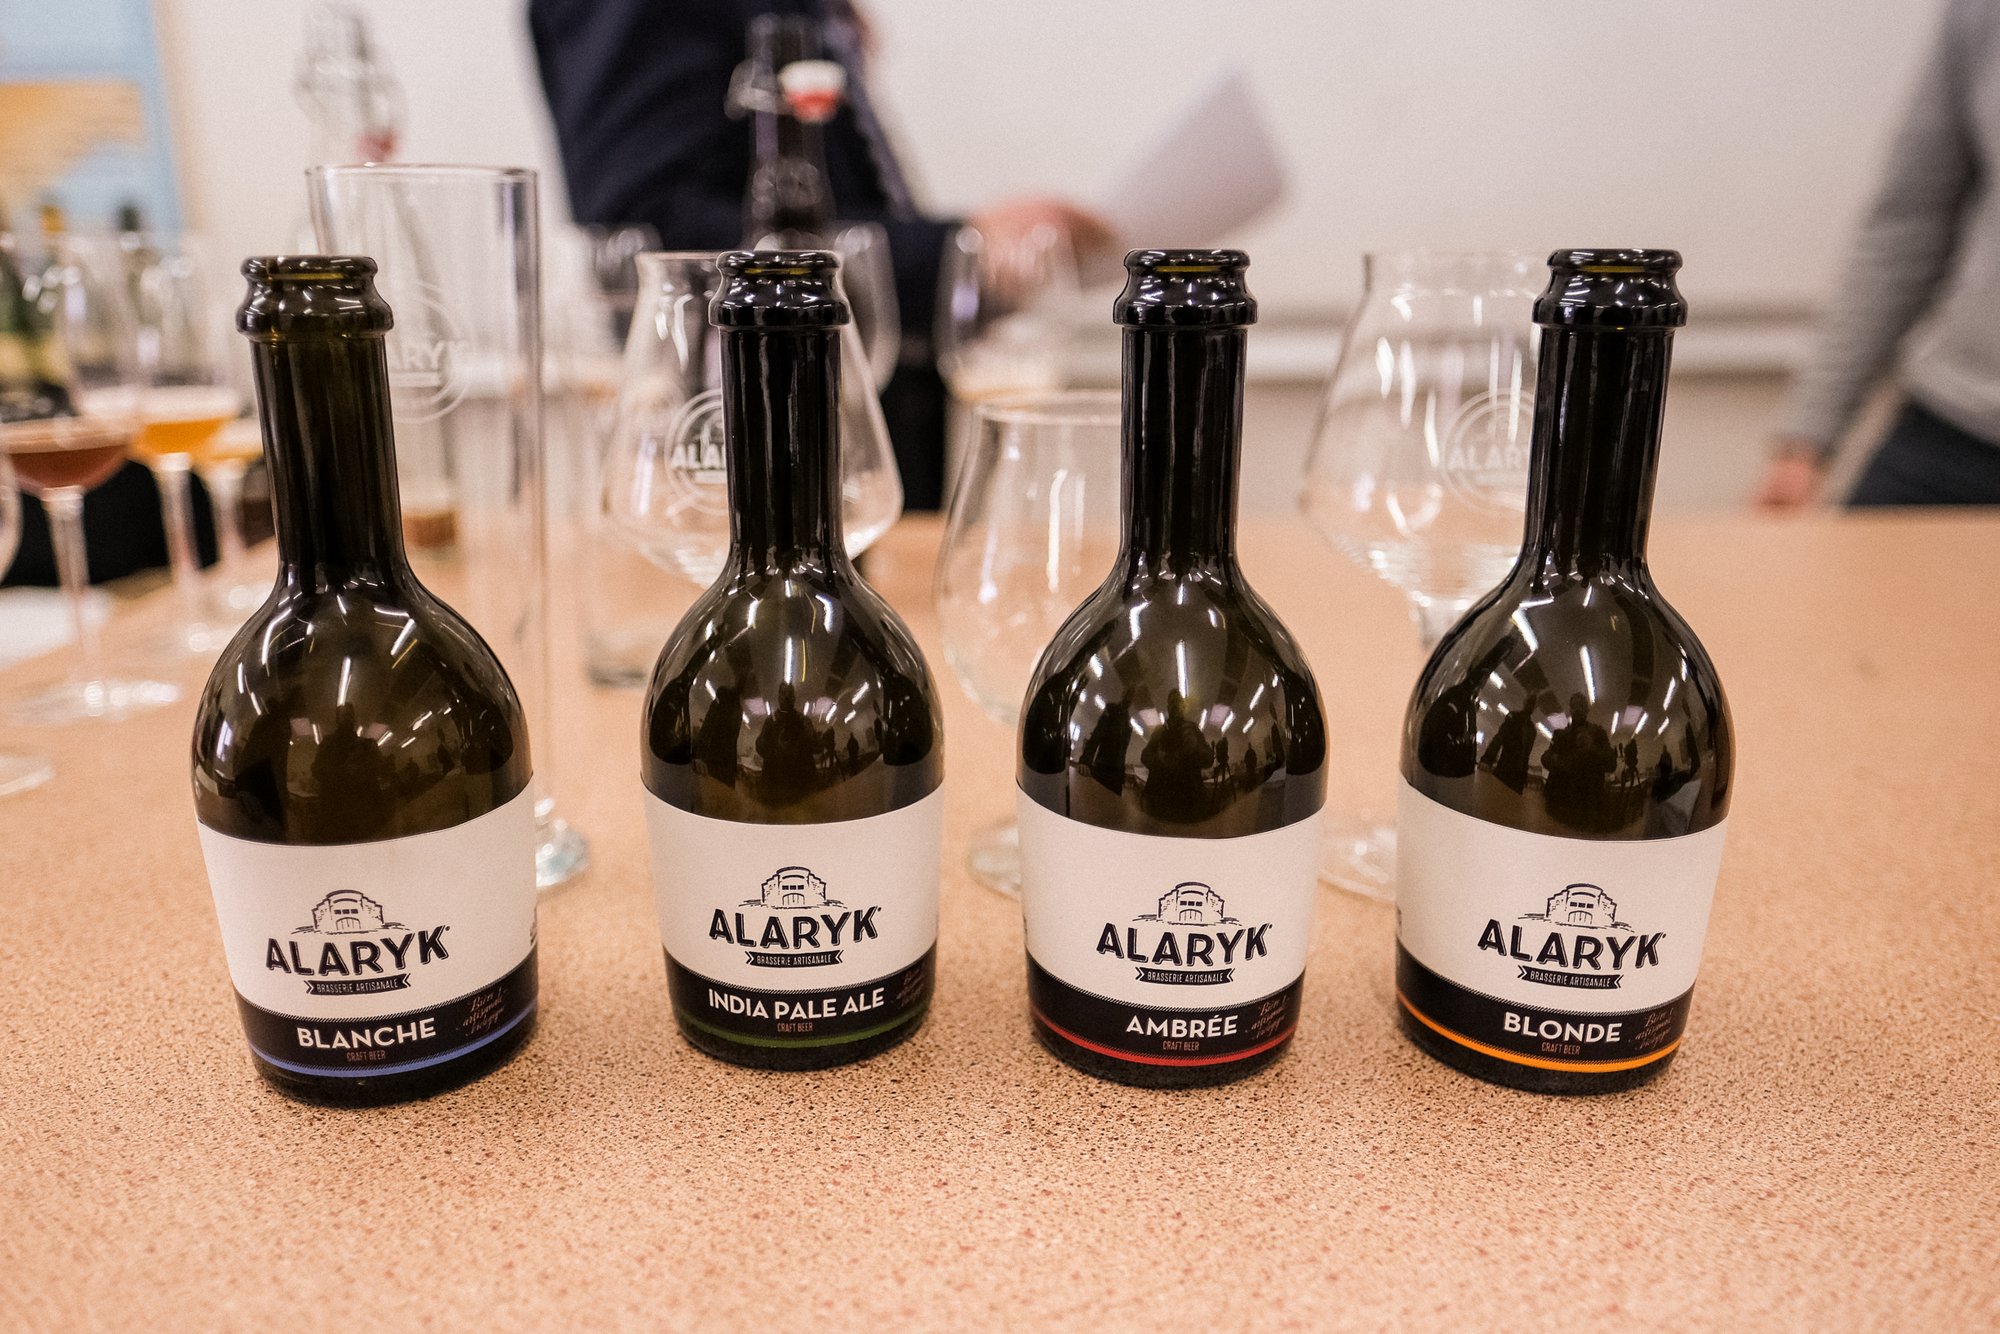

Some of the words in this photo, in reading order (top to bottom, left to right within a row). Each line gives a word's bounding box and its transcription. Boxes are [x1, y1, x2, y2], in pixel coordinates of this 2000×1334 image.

[708, 904, 879, 950] ALARYK
[265, 924, 450, 977] ALARYK
[1096, 922, 1270, 967] ALARYK
[1478, 918, 1665, 970] ALARYK
[756, 955, 791, 966] BRASSERIE
[792, 954, 832, 966] ARTISANALE
[316, 983, 354, 994] BRASSERIE
[355, 978, 399, 992] ARTISANALE
[1147, 971, 1183, 983] BRASSERIE
[1184, 972, 1224, 984] ARTISANALE
[1529, 970, 1568, 985] BRASSERIE
[1569, 974, 1611, 988] ARTISANALE
[708, 988, 770, 1019] INDIA
[774, 998, 837, 1020] PALE
[841, 987, 885, 1016] ALE
[296, 1017, 437, 1050] BLANCHE
[777, 1022, 796, 1033] CRAFT
[797, 1022, 814, 1032] BEER
[1125, 1014, 1239, 1039] AMBRÉE
[1503, 1011, 1623, 1044] BLONDE
[346, 1051, 367, 1062] CRAFT
[368, 1049, 386, 1061] BEER
[1162, 1040, 1182, 1050] CRAFT
[1183, 1041, 1200, 1051] BEER
[1541, 1041, 1562, 1053] CRAFT
[1563, 1044, 1581, 1055] BEER
